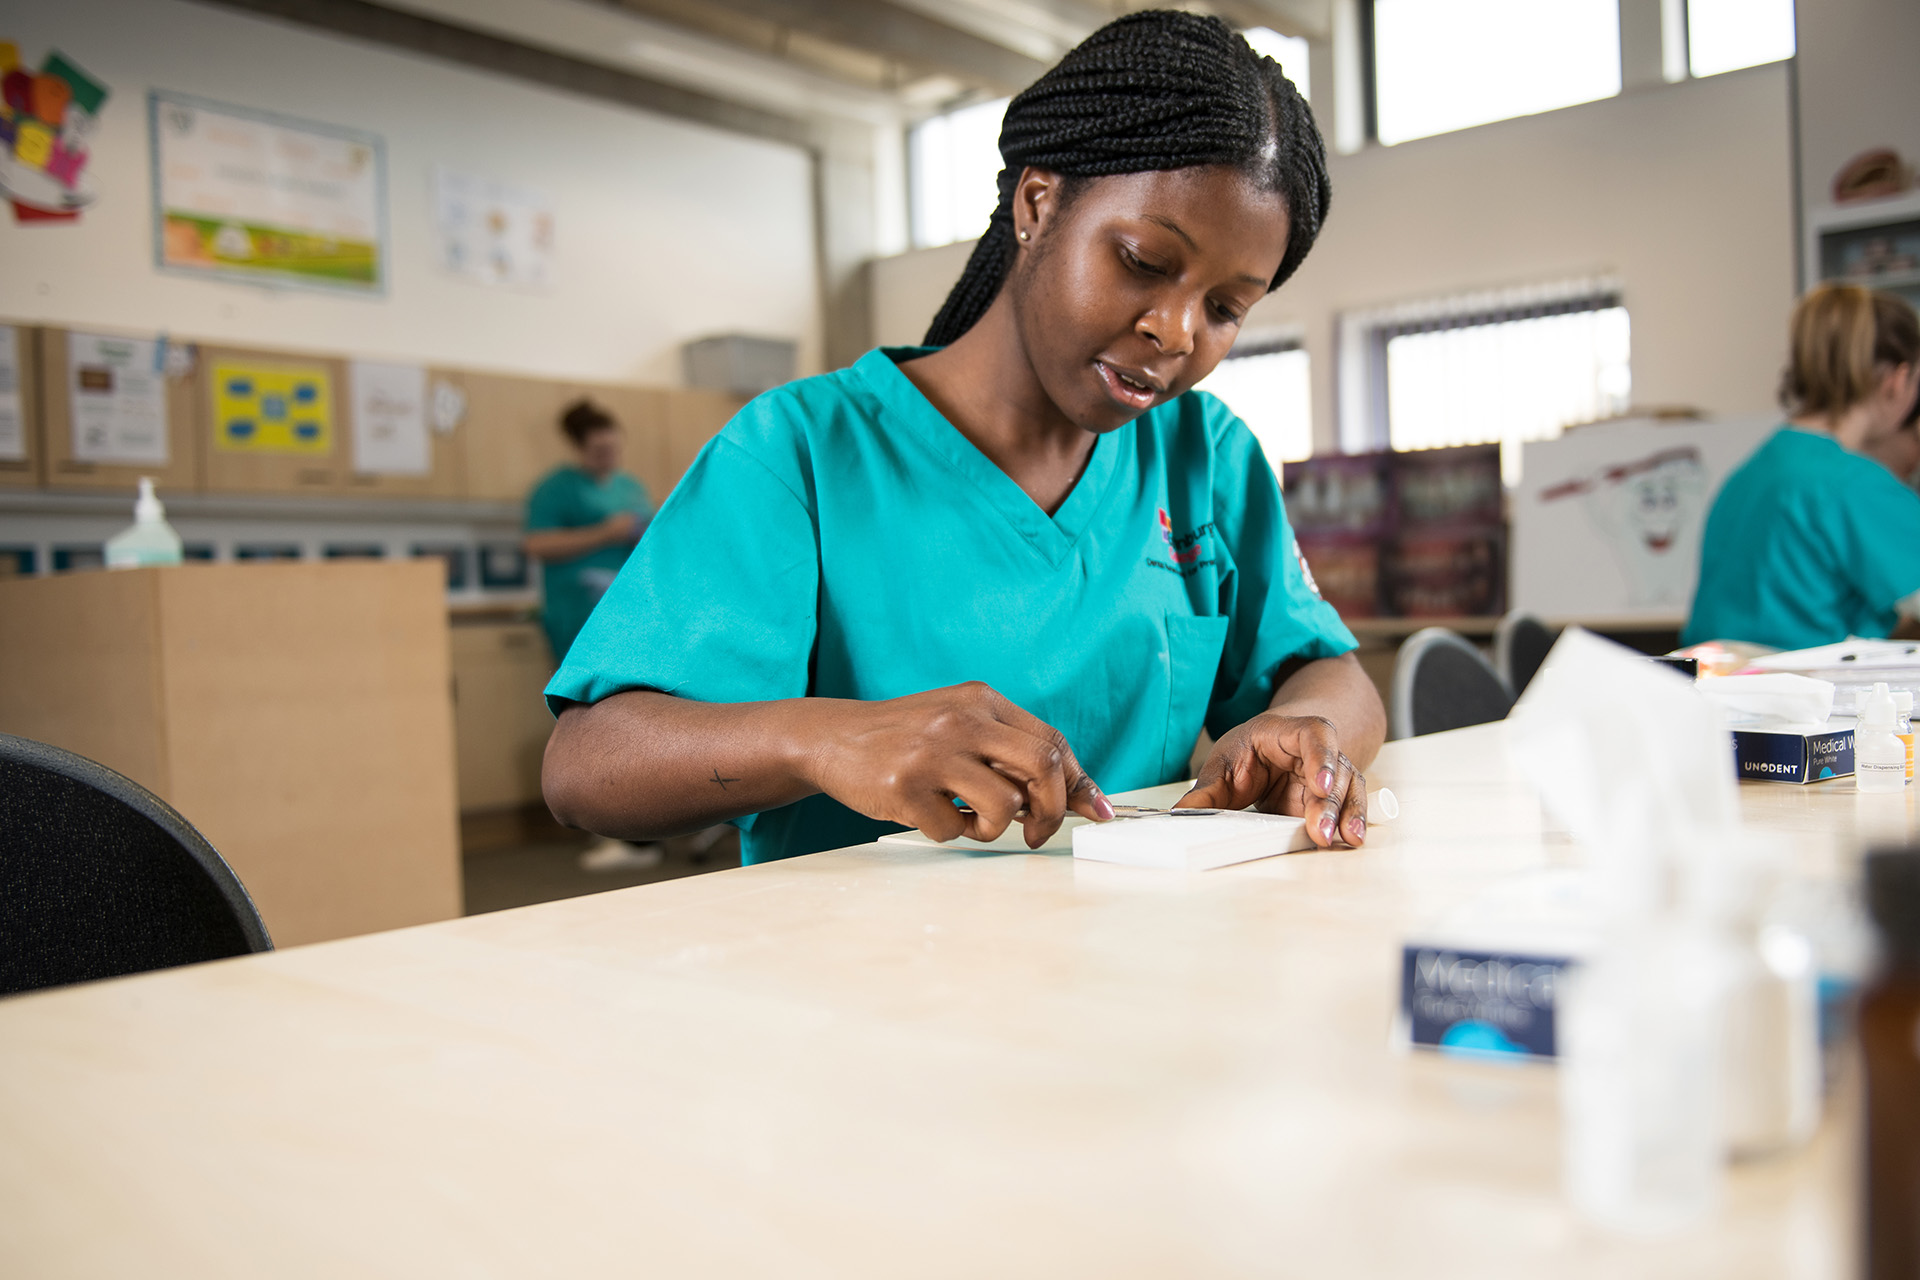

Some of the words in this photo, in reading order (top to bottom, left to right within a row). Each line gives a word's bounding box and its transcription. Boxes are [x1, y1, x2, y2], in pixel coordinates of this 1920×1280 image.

[1813, 736, 1847, 756] Medical
[1744, 761, 1798, 775] UNODENT
[1813, 757, 1824, 766] Pure
[1824, 755, 1838, 764] White
[1414, 946, 1557, 1011] Medica
